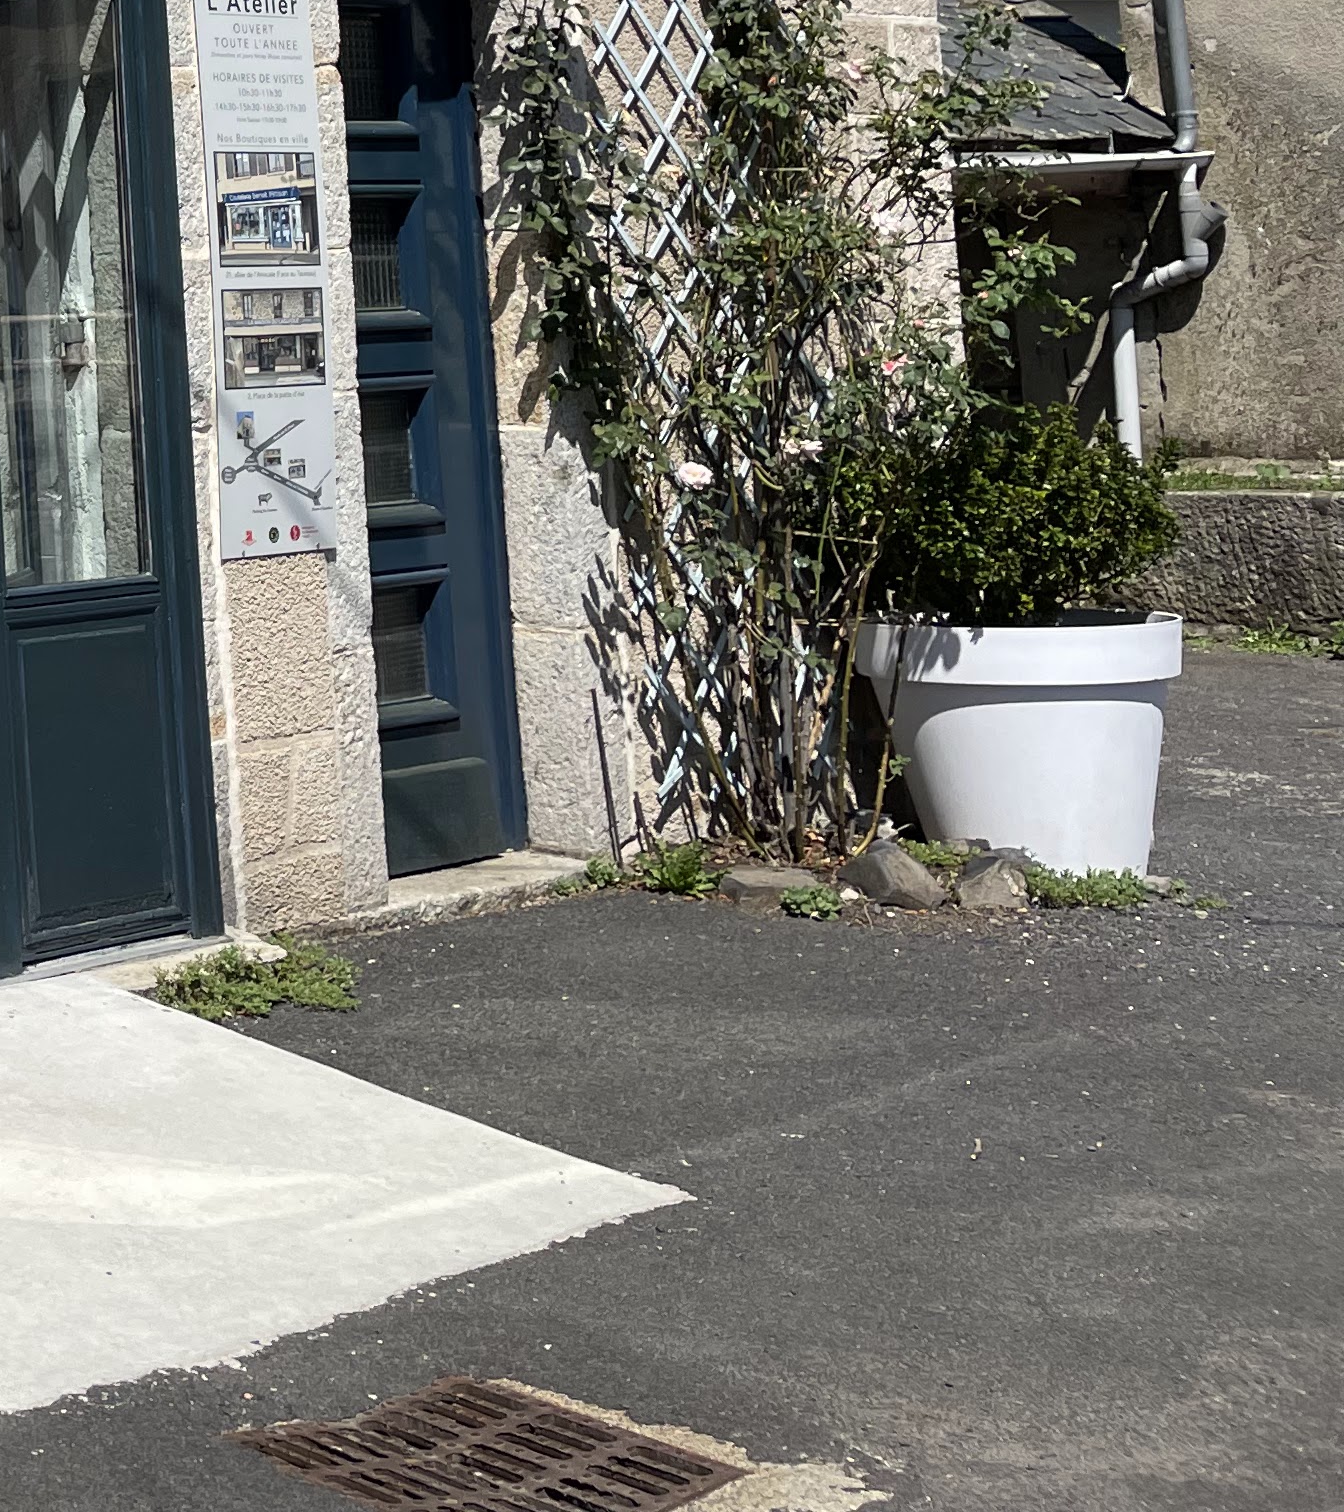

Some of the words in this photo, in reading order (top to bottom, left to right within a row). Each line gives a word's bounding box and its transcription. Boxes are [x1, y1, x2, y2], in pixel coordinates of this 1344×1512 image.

[232, 22, 274, 35] OUVERT
[214, 37, 249, 49] TOUTE
[213, 72, 257, 84] HORAIRES
[259, 73, 271, 84] DE
[273, 74, 304, 85] VISITES
[217, 133, 233, 143] Nos
[236, 133, 277, 146] Boutiques
[279, 136, 289, 144] en
[292, 133, 309, 144] ville
